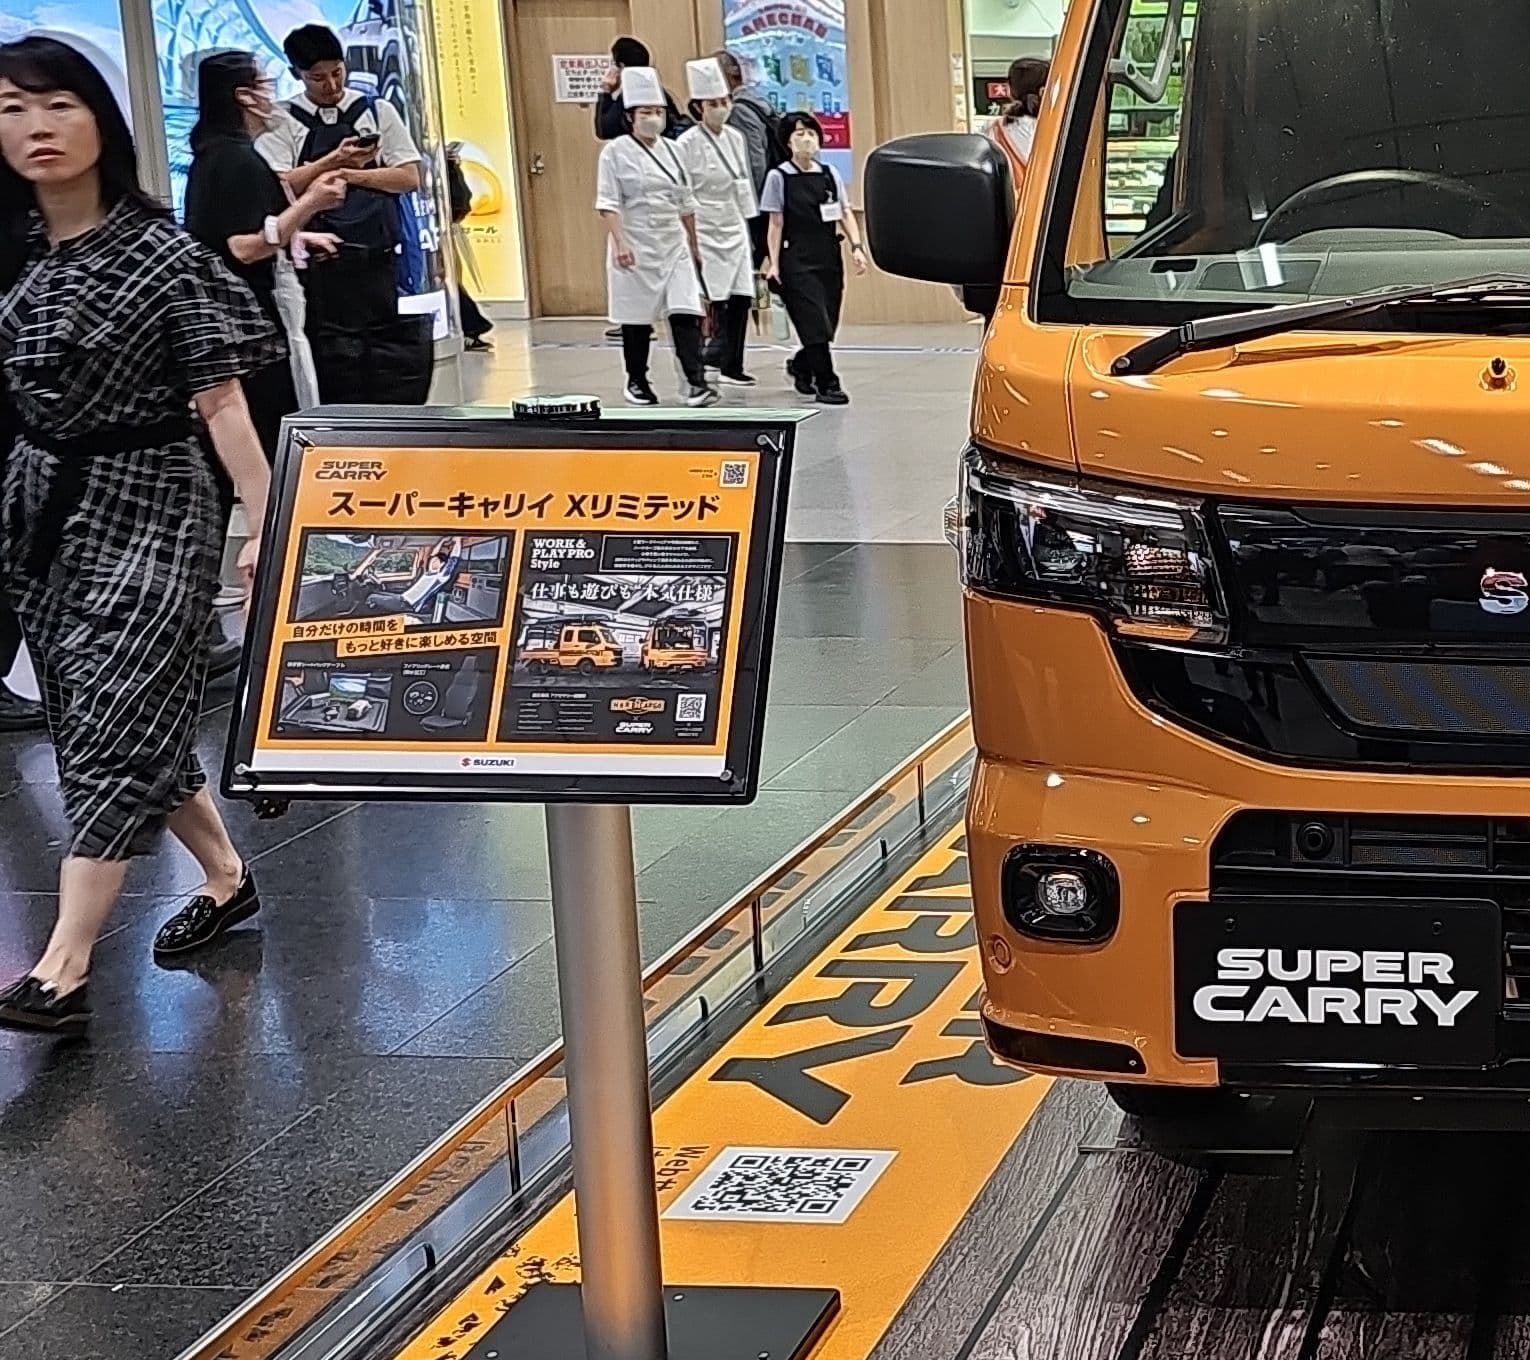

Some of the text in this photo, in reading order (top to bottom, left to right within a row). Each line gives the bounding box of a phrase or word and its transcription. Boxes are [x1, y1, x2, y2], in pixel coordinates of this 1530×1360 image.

[322, 461, 382, 470] SUPER
[315, 470, 387, 481] CARRY
[328, 491, 720, 520] スーパーキャリイ Xリミテッド
[533, 539, 586, 548] WORK &
[531, 549, 595, 559] PLAY PRO
[530, 559, 560, 571] Style
[293, 617, 400, 639] 自分だけの時間を
[345, 631, 498, 653] もっと好きに楽しめる空間
[473, 759, 515, 767] SUZUKI
[1217, 948, 1454, 984] SUPER
[1193, 985, 1479, 1026] CARRY
